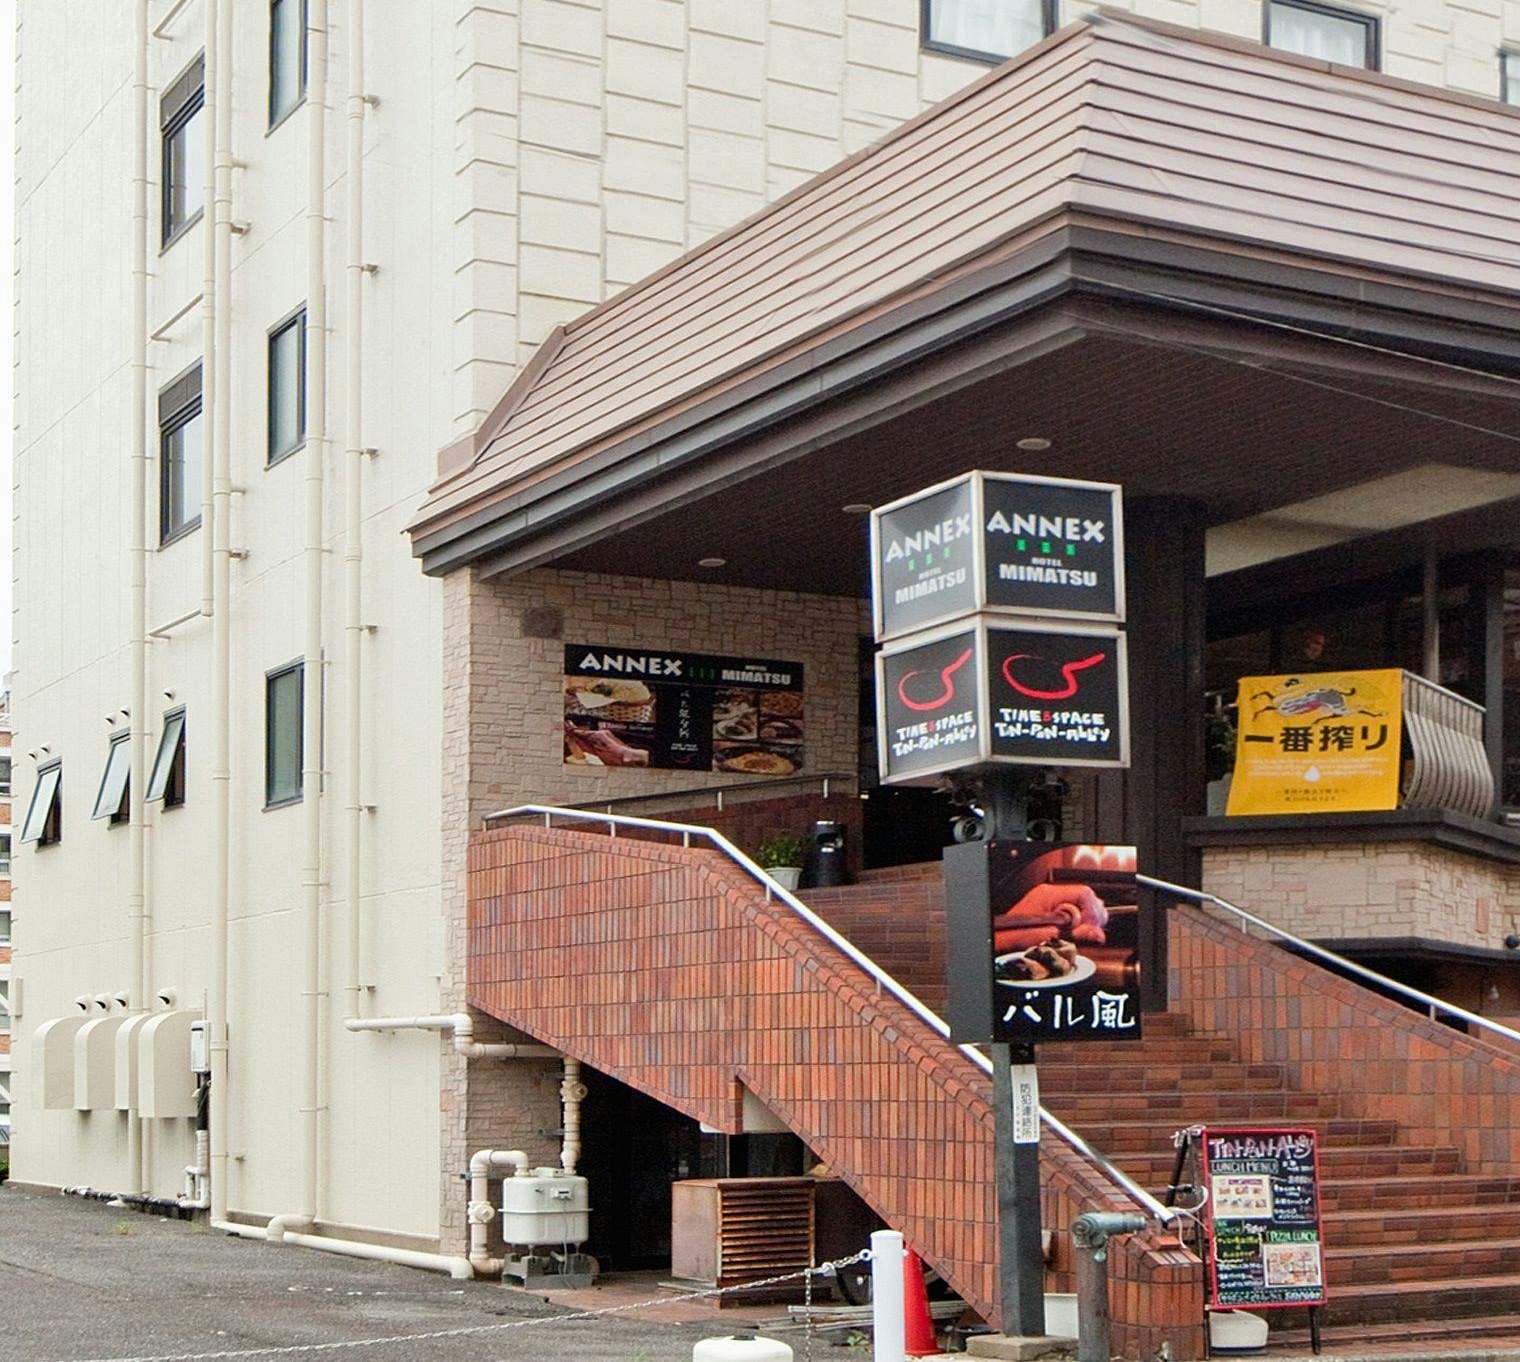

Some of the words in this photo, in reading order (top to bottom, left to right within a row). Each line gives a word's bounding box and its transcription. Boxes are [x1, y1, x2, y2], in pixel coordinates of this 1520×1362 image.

[886, 513, 970, 563] ANNEX
[986, 510, 1105, 543] ANNEX
[999, 563, 1097, 587] MIMATSU
[1031, 557, 1062, 567] HOTEL
[895, 568, 966, 604] MIMATSU
[579, 652, 683, 677] ANNEX
[722, 669, 791, 685] MIMATSU
[999, 708, 1042, 722] TIME
[1052, 711, 1105, 725] SPACE
[1244, 725, 1388, 752] 一番搾り
[1003, 990, 1136, 1029] バル風
